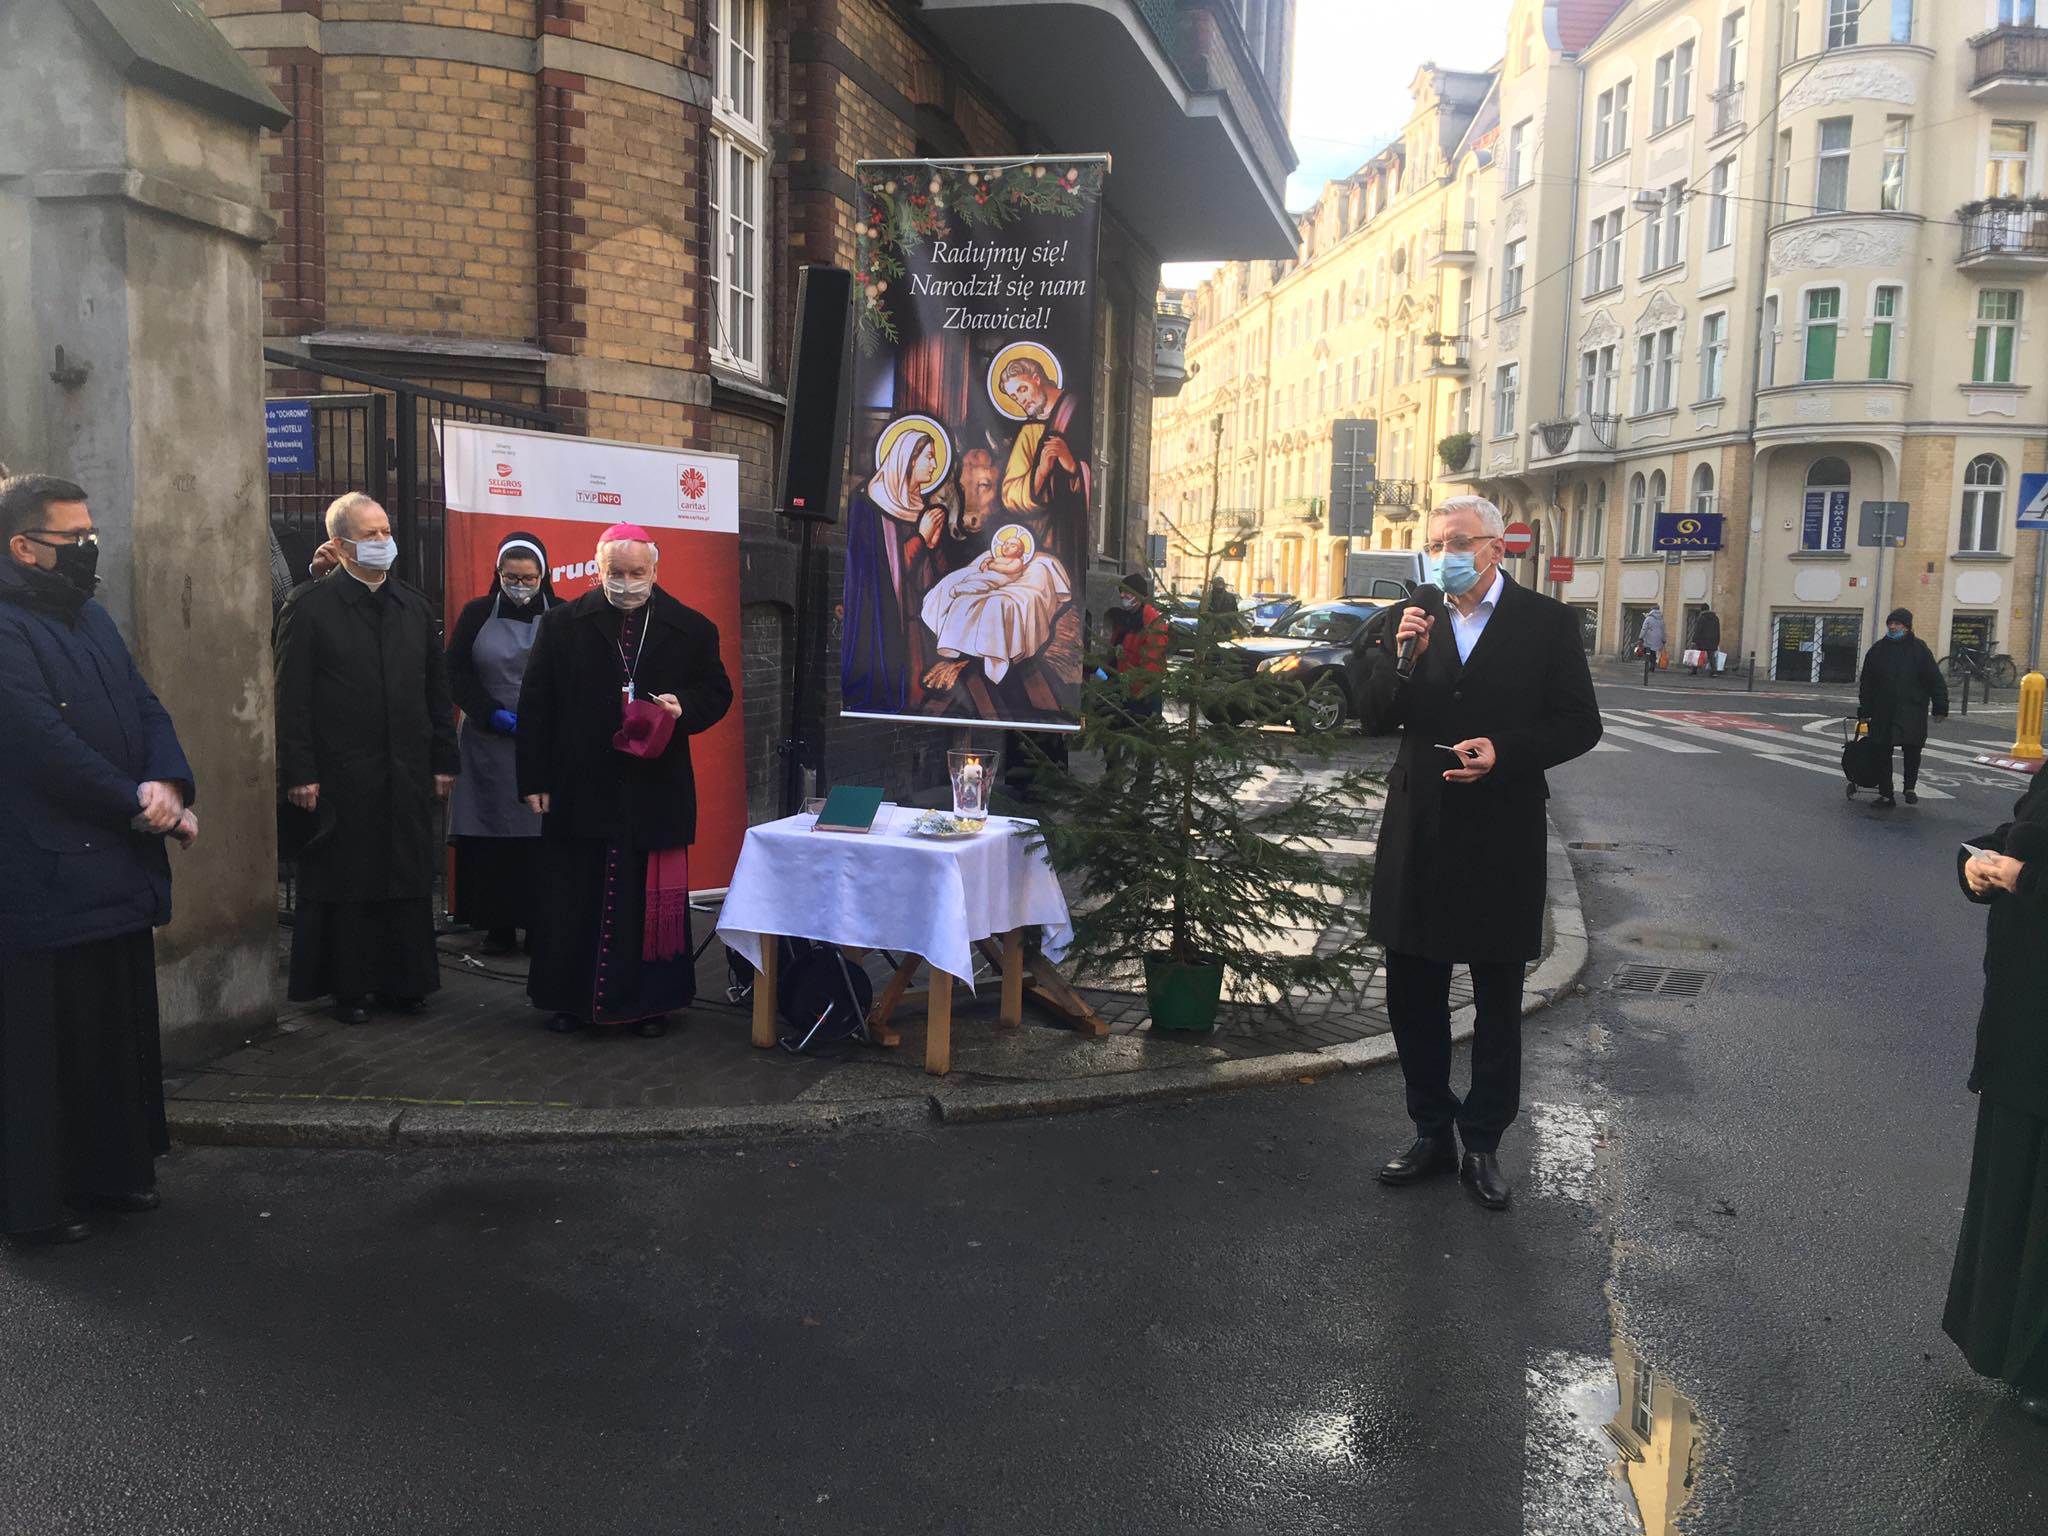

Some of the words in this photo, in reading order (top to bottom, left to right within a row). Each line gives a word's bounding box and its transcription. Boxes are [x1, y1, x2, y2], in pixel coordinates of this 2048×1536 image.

[930, 240, 1027, 270] Radujmy
[1031, 239, 1069, 267] się!
[909, 273, 1002, 297] Narodził
[1006, 274, 1034, 301] się
[1040, 278, 1087, 297] nam
[942, 307, 1052, 330] Zbawiciel!
[281, 425, 303, 433] HOTELU
[488, 478, 522, 488] SELGROS
[599, 494, 621, 504] INFO
[680, 502, 706, 511] caritas
[1658, 537, 1717, 546] OPAL
